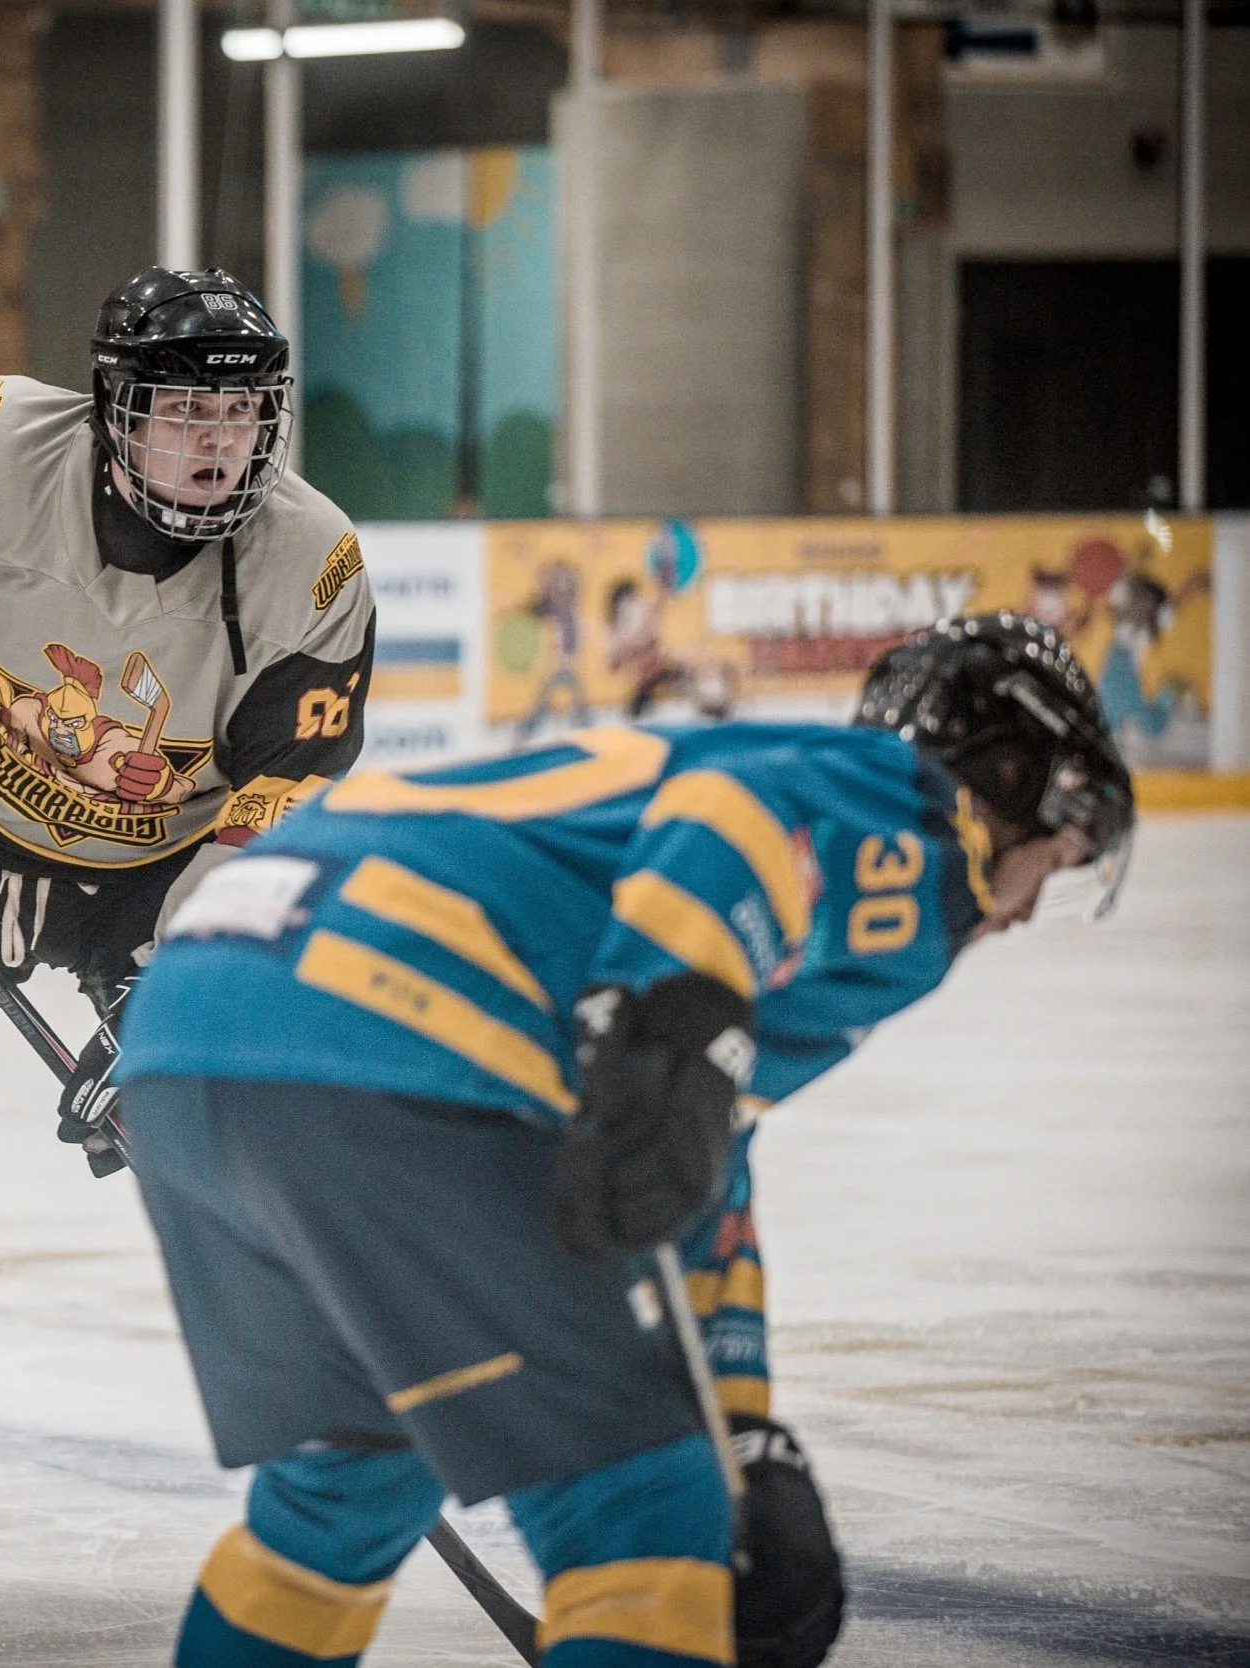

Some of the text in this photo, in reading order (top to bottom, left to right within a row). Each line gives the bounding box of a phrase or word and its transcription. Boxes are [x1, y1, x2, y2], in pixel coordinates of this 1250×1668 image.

[201, 293, 238, 311] 86
[97, 354, 118, 365] CCM
[206, 354, 257, 365] CCM
[847, 829, 924, 955] 30
